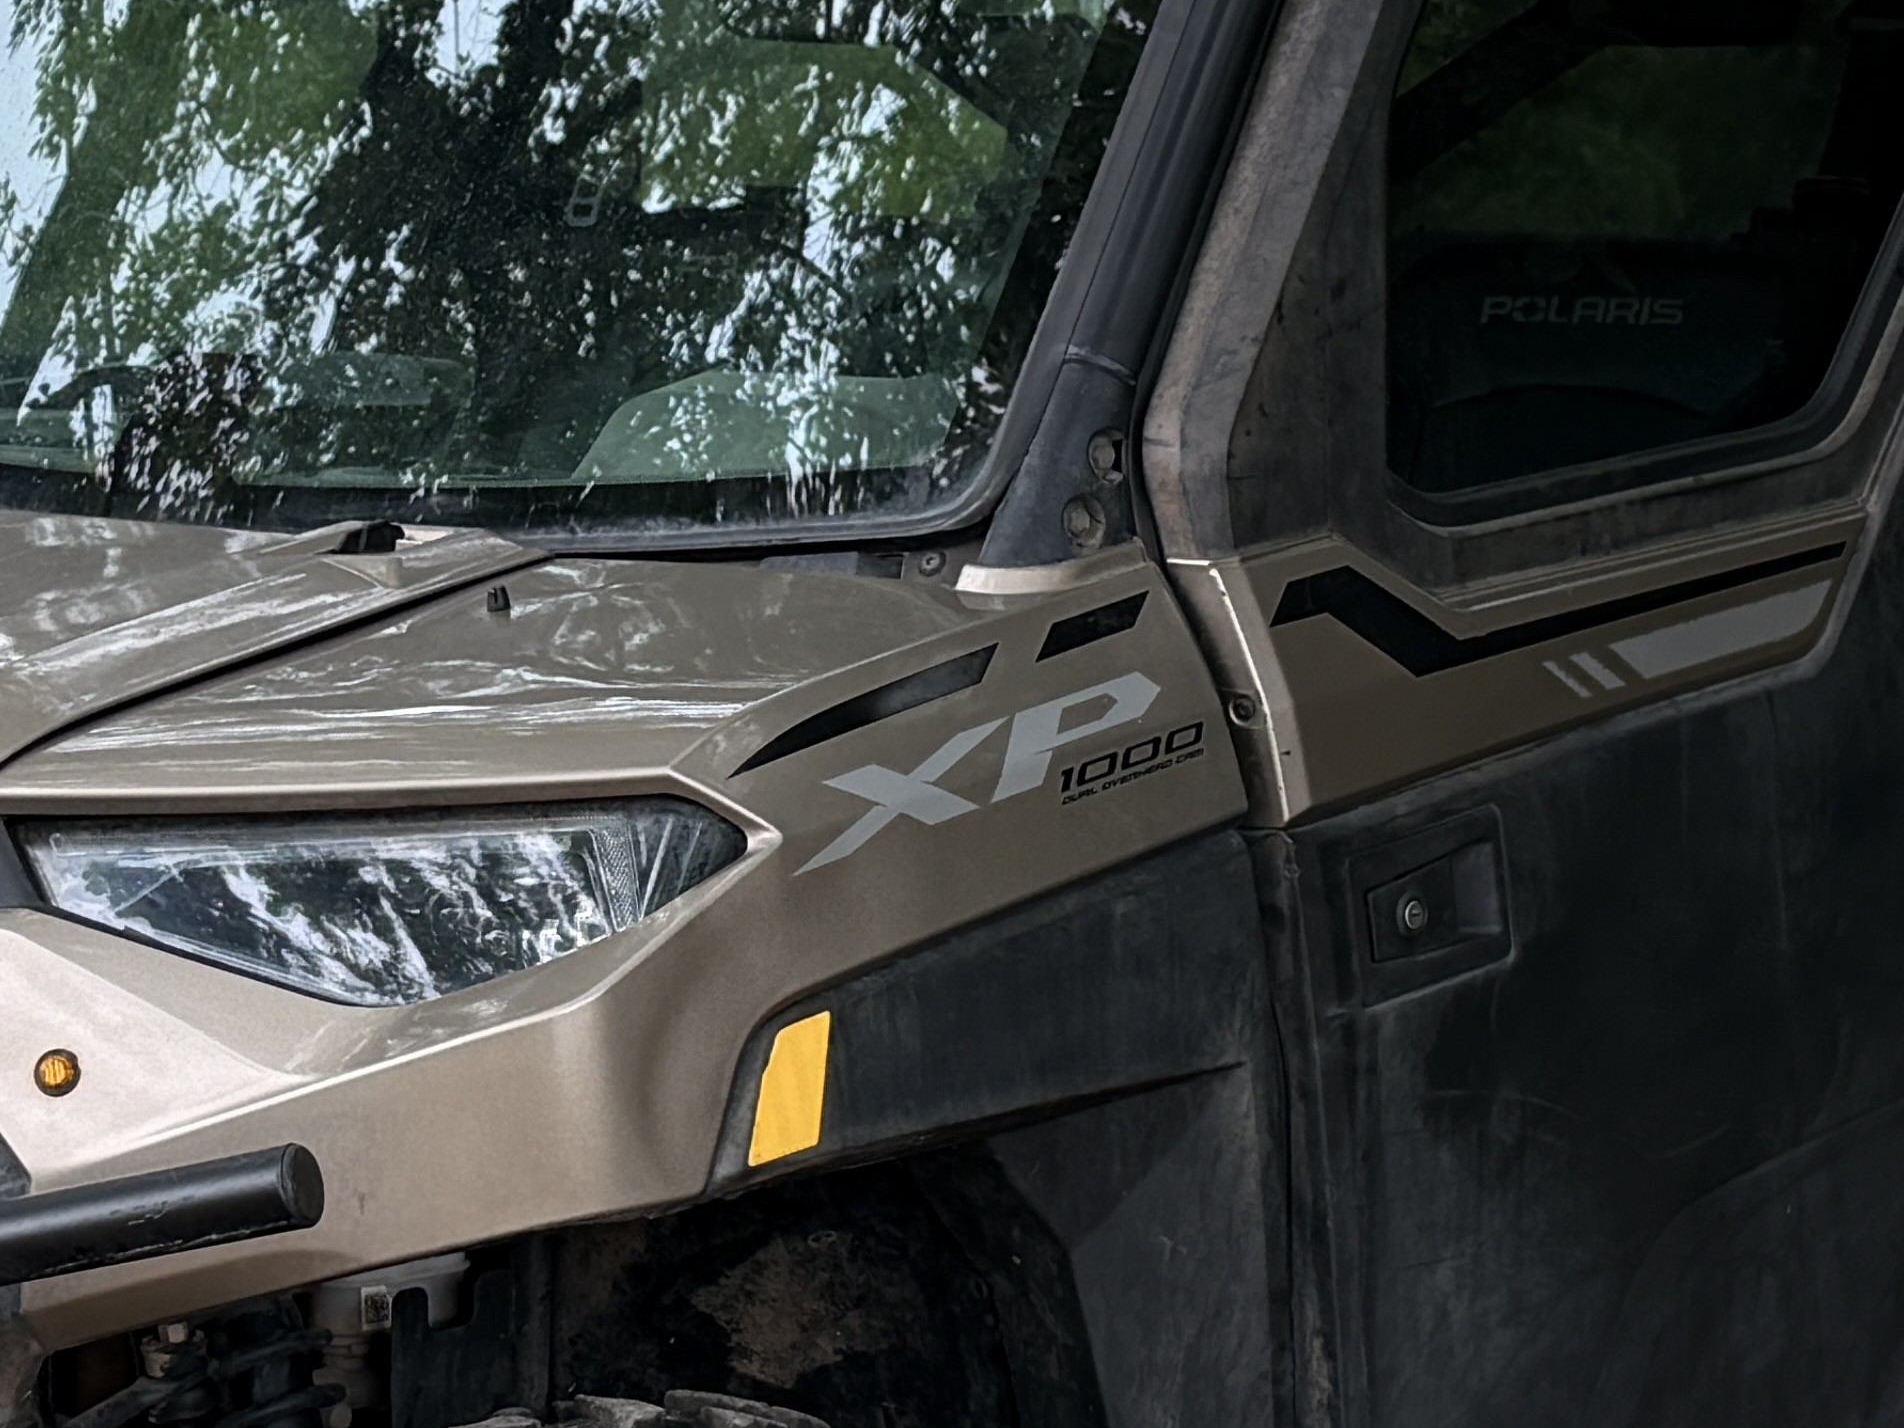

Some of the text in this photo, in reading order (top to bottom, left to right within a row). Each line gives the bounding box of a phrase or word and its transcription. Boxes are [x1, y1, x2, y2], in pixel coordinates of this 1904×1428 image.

[1478, 294, 1686, 326] POLARIS
[791, 670, 1204, 877] XP 1000
[1061, 786, 1098, 805] DUAL
